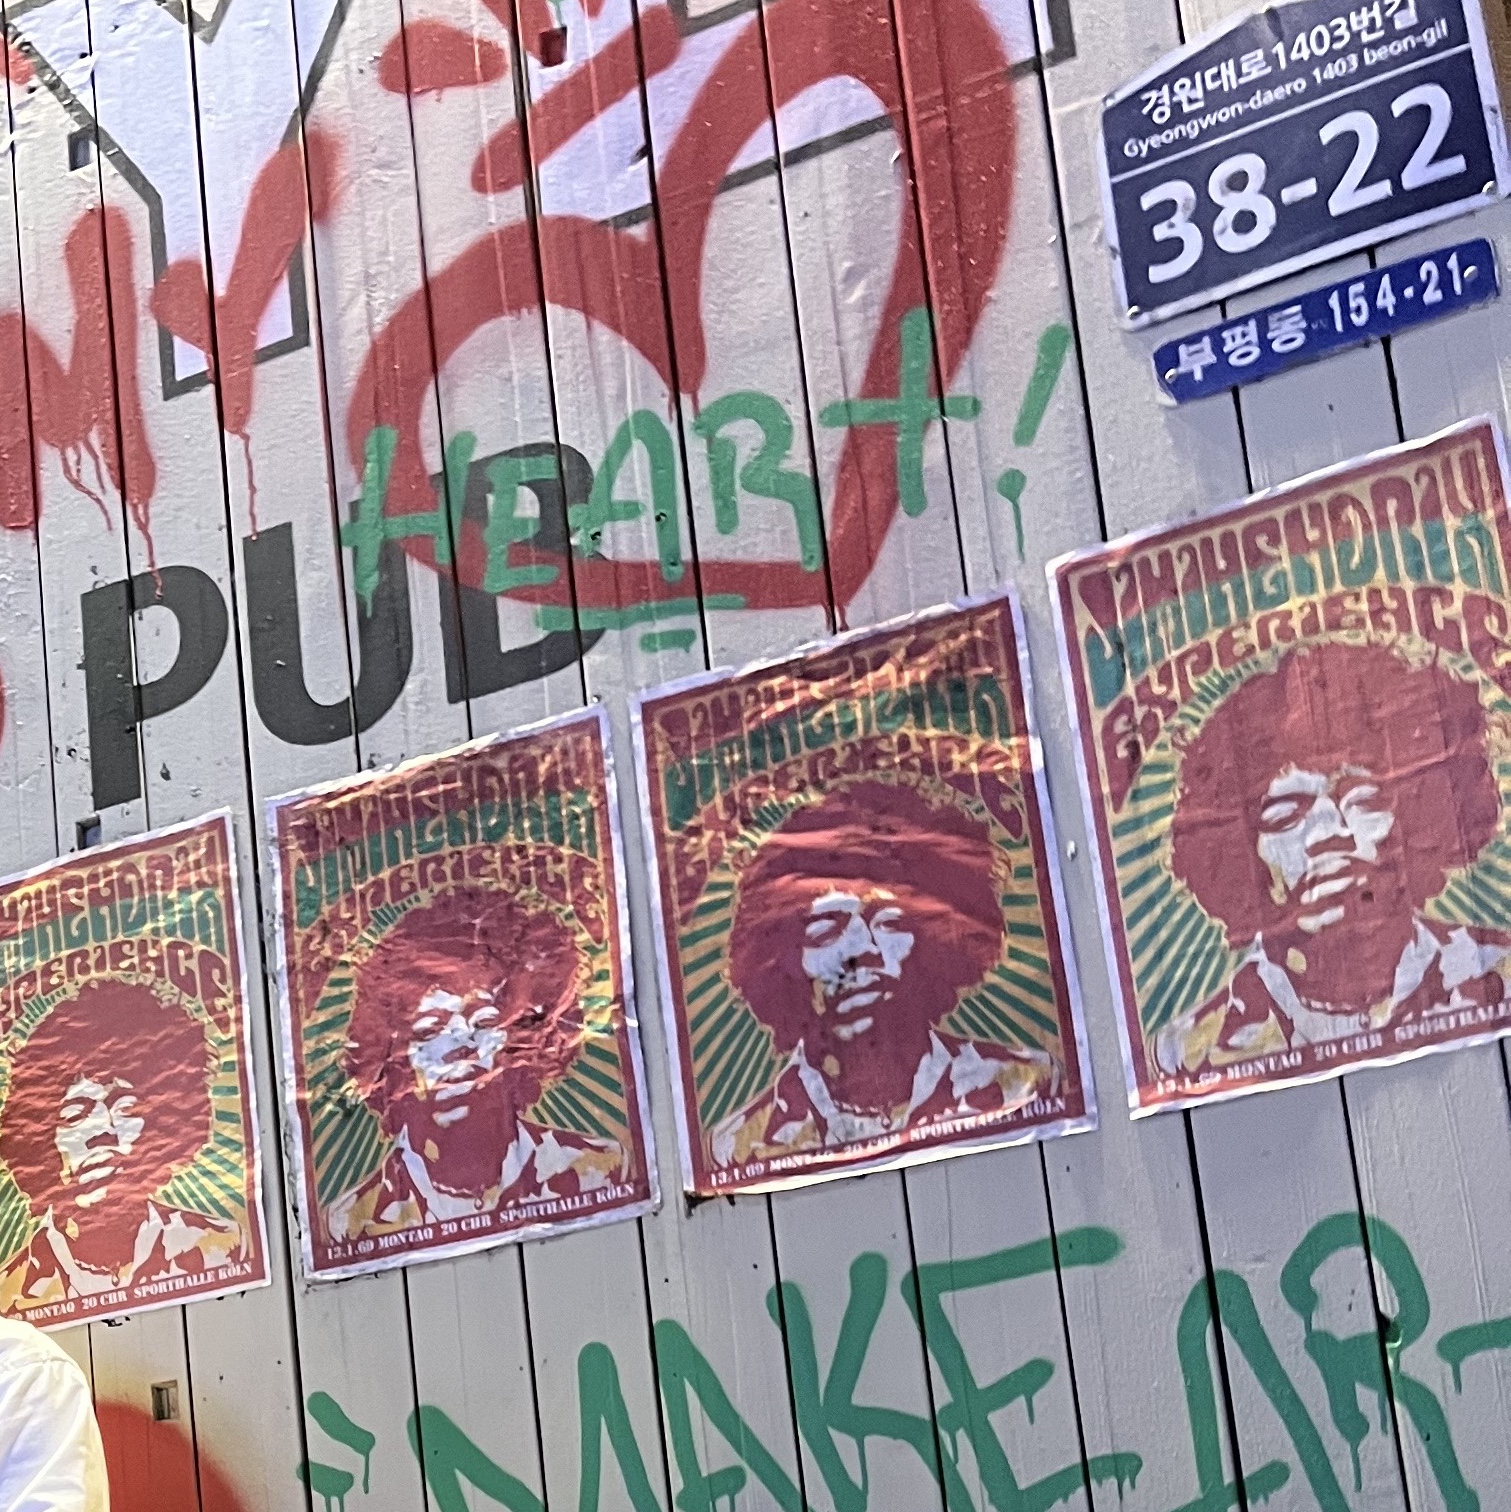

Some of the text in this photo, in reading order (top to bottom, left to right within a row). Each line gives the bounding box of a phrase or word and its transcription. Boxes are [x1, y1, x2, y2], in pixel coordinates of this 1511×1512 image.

[1123, 18, 1448, 158] Gyeongwon-daero 1403 beon-gil
[1140, 83, 1467, 283] 38-22
[1178, 252, 1463, 382] 부평동 154-21
[133, 1270, 215, 1299] SPORTHALLE
[218, 1262, 252, 1283] KÖLN
